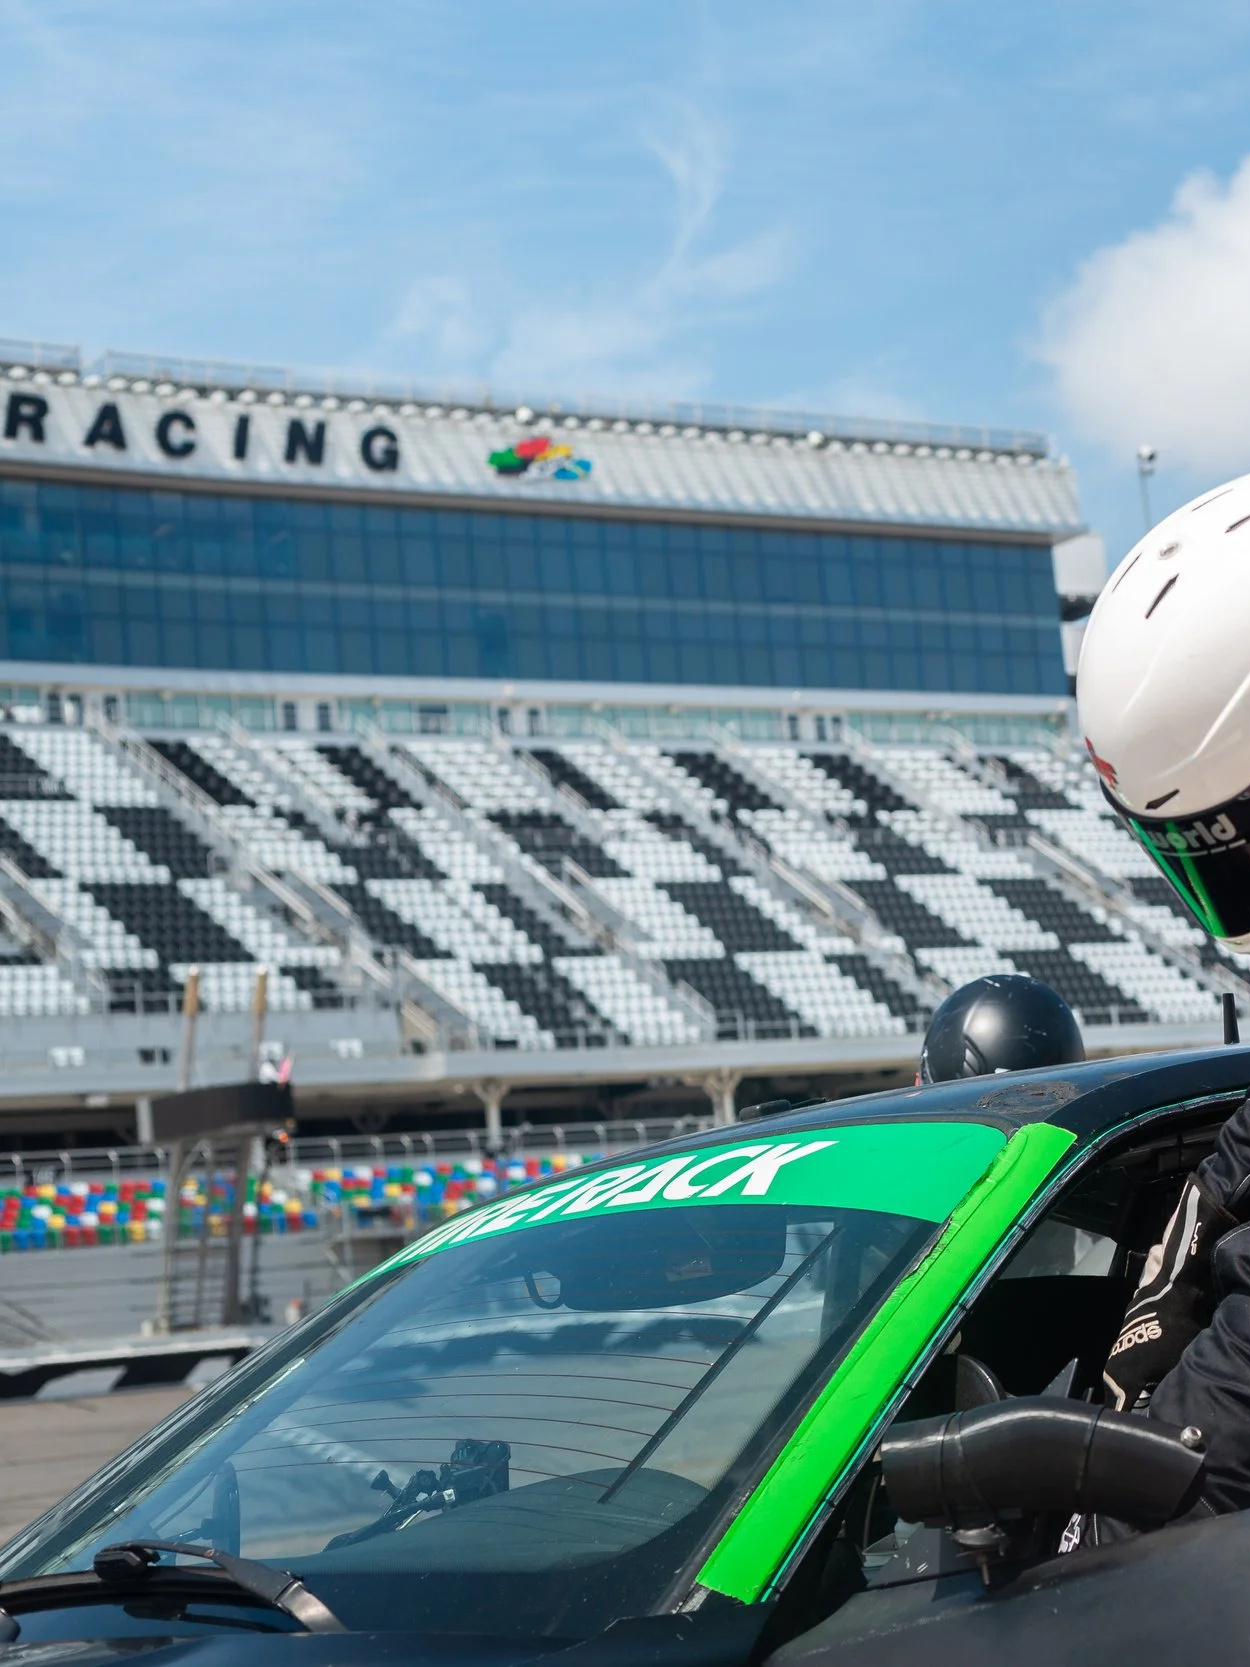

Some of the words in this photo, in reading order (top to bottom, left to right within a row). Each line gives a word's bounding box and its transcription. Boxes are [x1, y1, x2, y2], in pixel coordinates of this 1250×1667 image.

[4, 392, 399, 472] RACING
[525, 1141, 839, 1222] RACK
[1111, 1321, 1163, 1357] sparco
